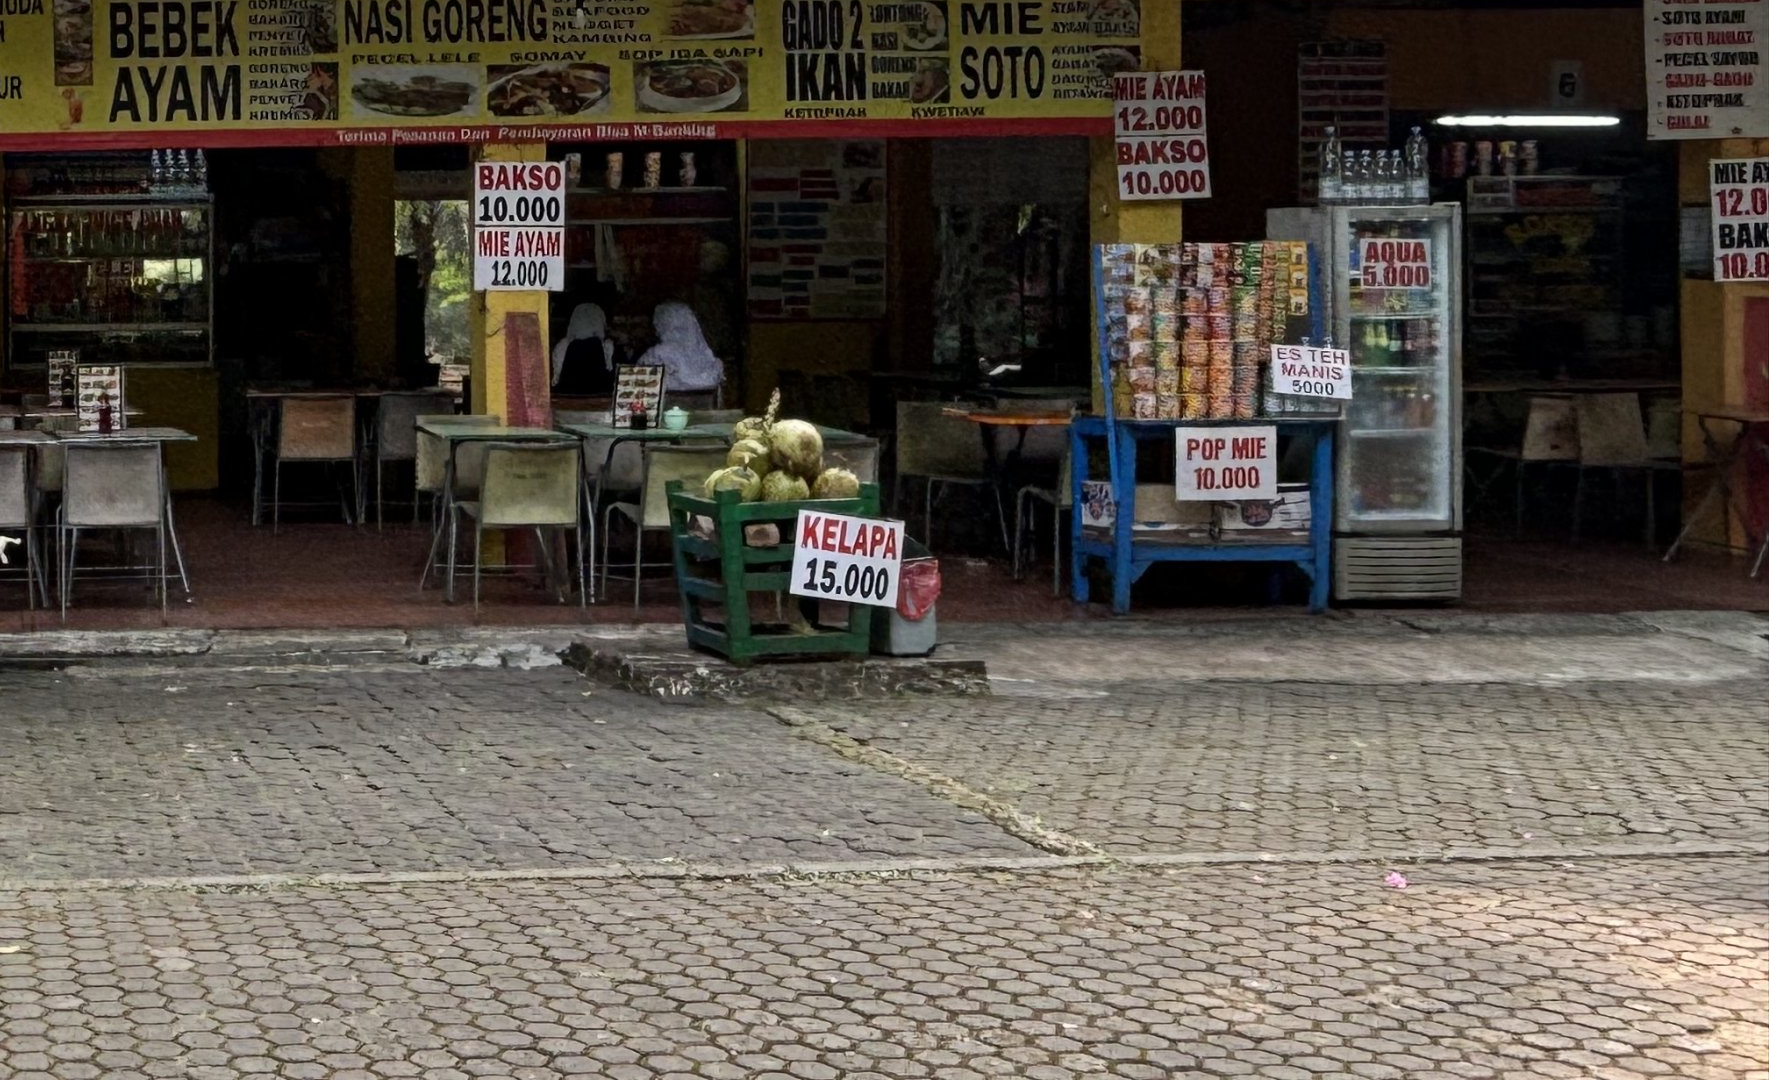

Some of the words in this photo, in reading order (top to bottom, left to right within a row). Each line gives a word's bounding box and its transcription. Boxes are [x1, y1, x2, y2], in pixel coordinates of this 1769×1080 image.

[110, 1, 239, 58] BEBEK
[344, 0, 412, 44] NASI
[782, 0, 843, 50] GADO
[850, 0, 864, 50] 2
[961, 2, 1044, 35] MIE
[552, 34, 651, 44] KAMBING
[785, 53, 866, 101] IKAN
[960, 45, 1045, 99] SOTO
[110, 65, 241, 123] AYAM
[1114, 77, 1146, 101] MIE
[1151, 74, 1206, 100] AYAM
[1118, 106, 1202, 131] 12.000
[1117, 138, 1206, 165] BAKSO
[479, 164, 561, 189] BAKSO
[1122, 169, 1206, 195] 10.000
[1715, 163, 1747, 184] MIE
[480, 196, 561, 222] 10.000
[478, 227, 510, 257] MIE
[515, 226, 561, 256] AYAM
[1365, 241, 1427, 265] AQUA
[491, 260, 548, 287] 12.000
[1363, 265, 1429, 287] 5.000
[1277, 347, 1302, 361] ES
[1308, 349, 1346, 365] TEH
[1282, 363, 1343, 380] MANIS
[1293, 380, 1334, 395] 5000
[1187, 438, 1226, 460] POP
[1232, 437, 1266, 460] MIE
[1195, 466, 1259, 489] 10.000
[801, 514, 896, 560] KELAPA
[803, 557, 889, 600] 15.000
